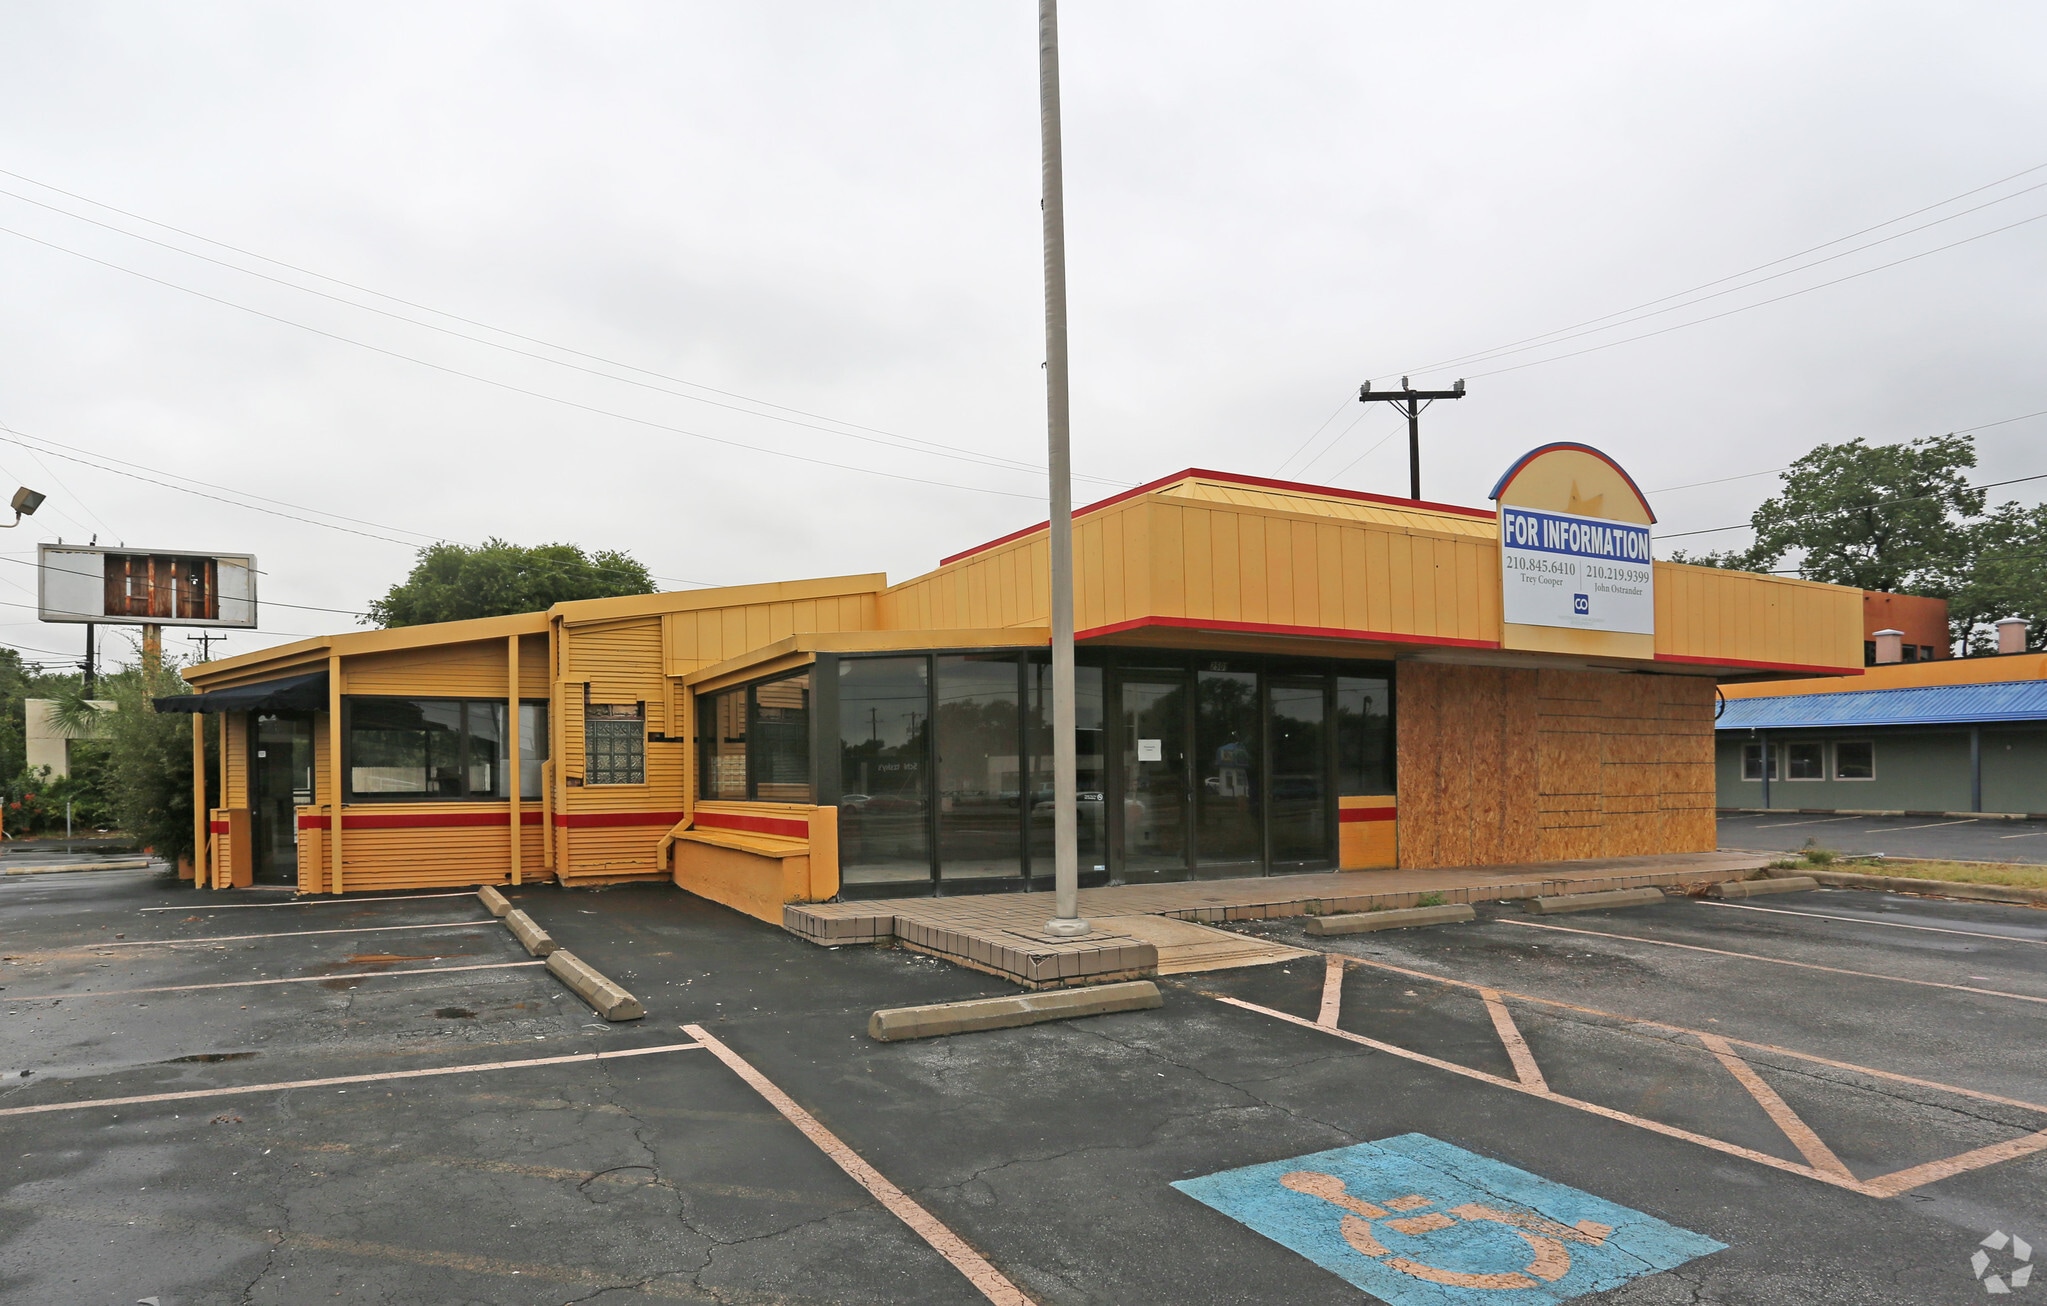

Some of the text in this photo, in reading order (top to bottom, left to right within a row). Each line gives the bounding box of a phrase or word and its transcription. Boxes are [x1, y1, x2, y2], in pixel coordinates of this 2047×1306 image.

[1505, 513, 1649, 560] FOR INFORMATION
[1506, 556, 1576, 576] 210.845.6410
[1586, 565, 1649, 584] 210.219.9399
[1520, 573, 1564, 588] Trey Cooper
[1594, 583, 1643, 596] John Ostrander
